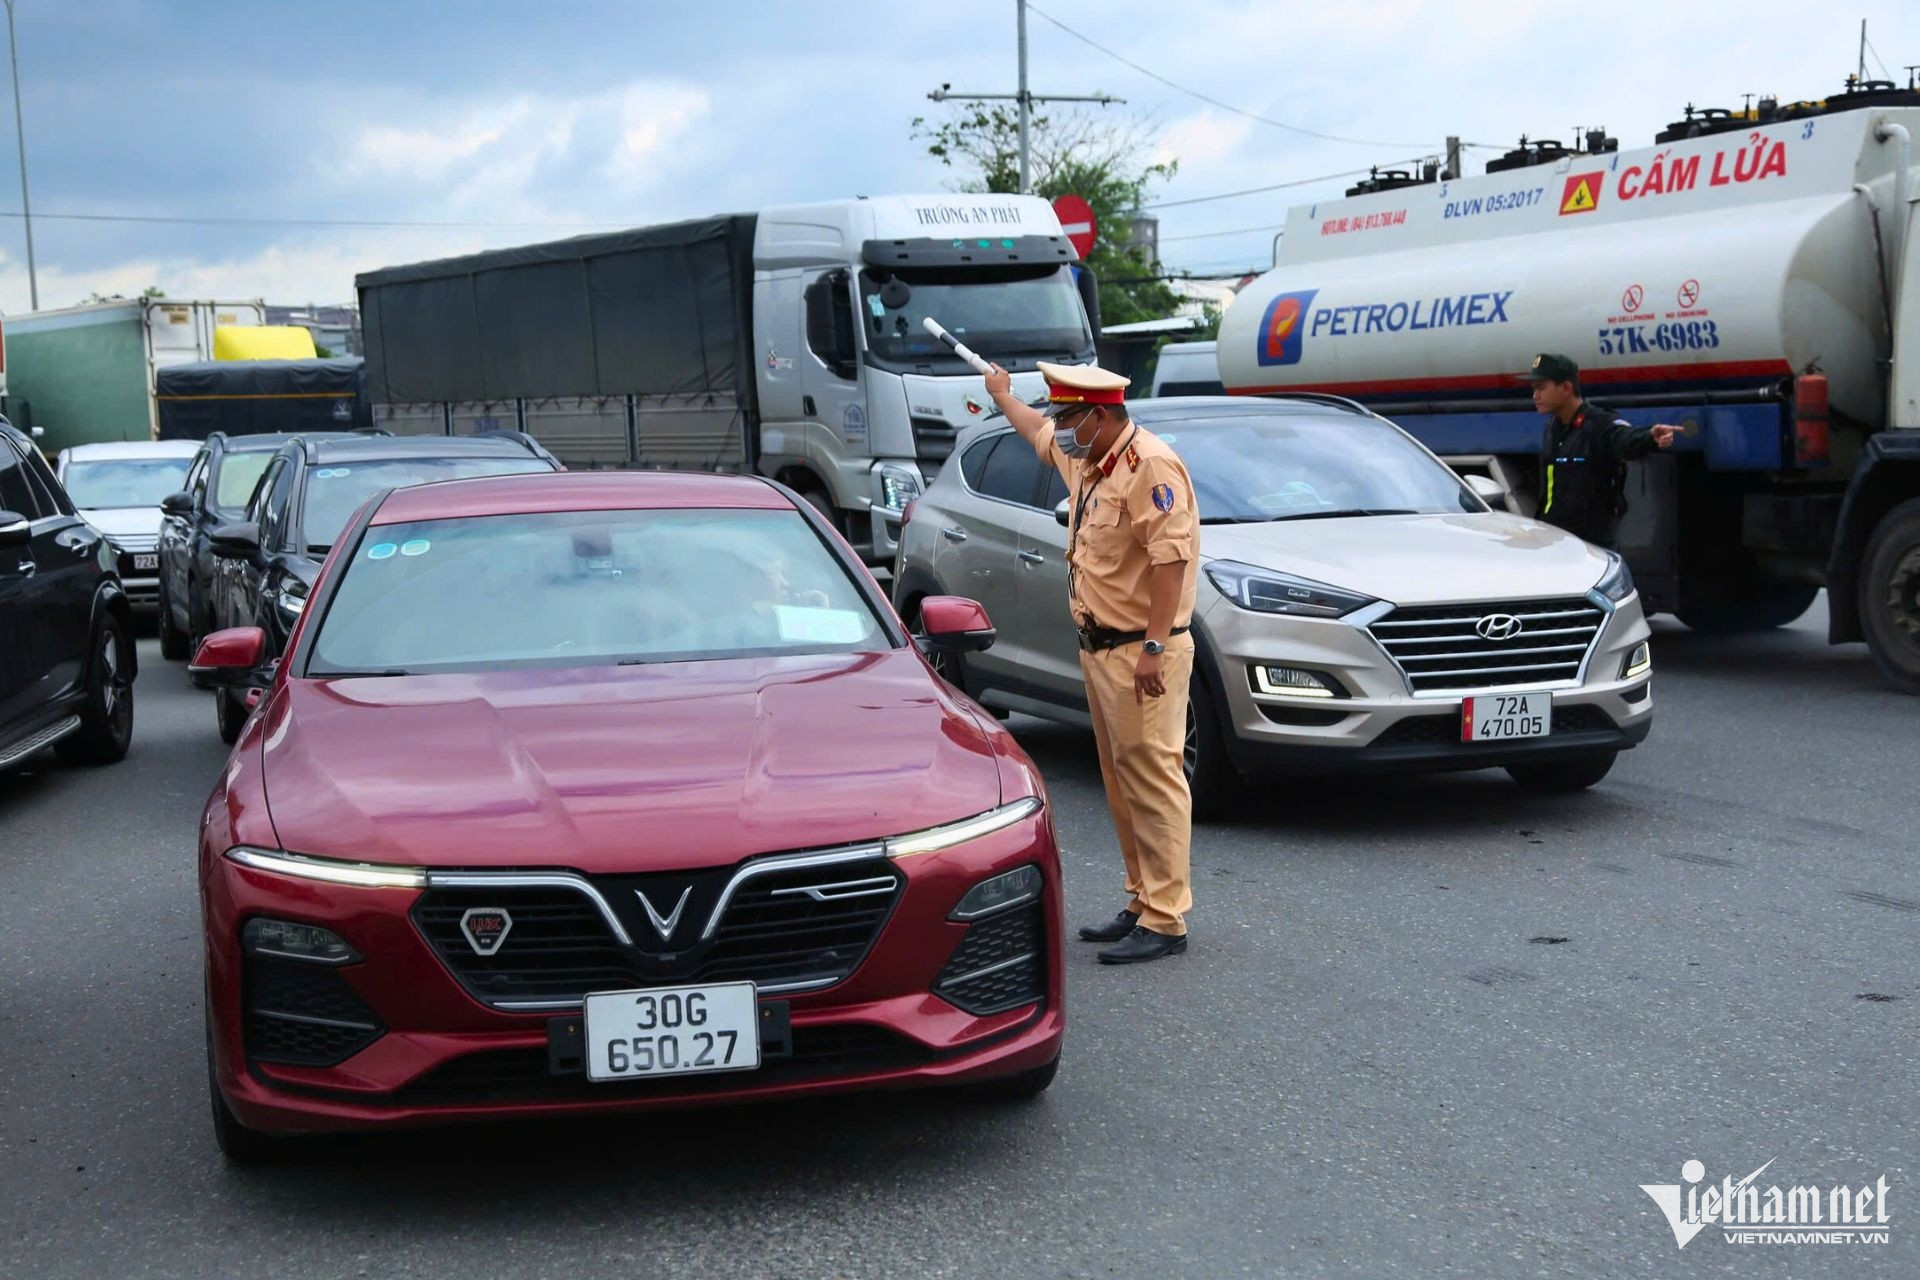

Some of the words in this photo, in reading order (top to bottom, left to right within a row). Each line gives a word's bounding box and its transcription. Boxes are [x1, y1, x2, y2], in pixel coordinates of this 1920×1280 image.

[1801, 121, 1815, 140] 3
[1617, 149, 1701, 201] CẤM
[1709, 131, 1787, 188] LỬA
[1443, 198, 1484, 219] ĐLVN
[1485, 187, 1544, 214] 05:2017
[1310, 291, 1514, 337] PETROLIMEX
[1598, 320, 1720, 355] 57K-6983
[1496, 696, 1528, 715] 72A
[1480, 716, 1543, 738] 470.05
[470, 917, 501, 931] LUX
[634, 992, 708, 1030] 30G
[607, 1030, 739, 1073] 650.27
